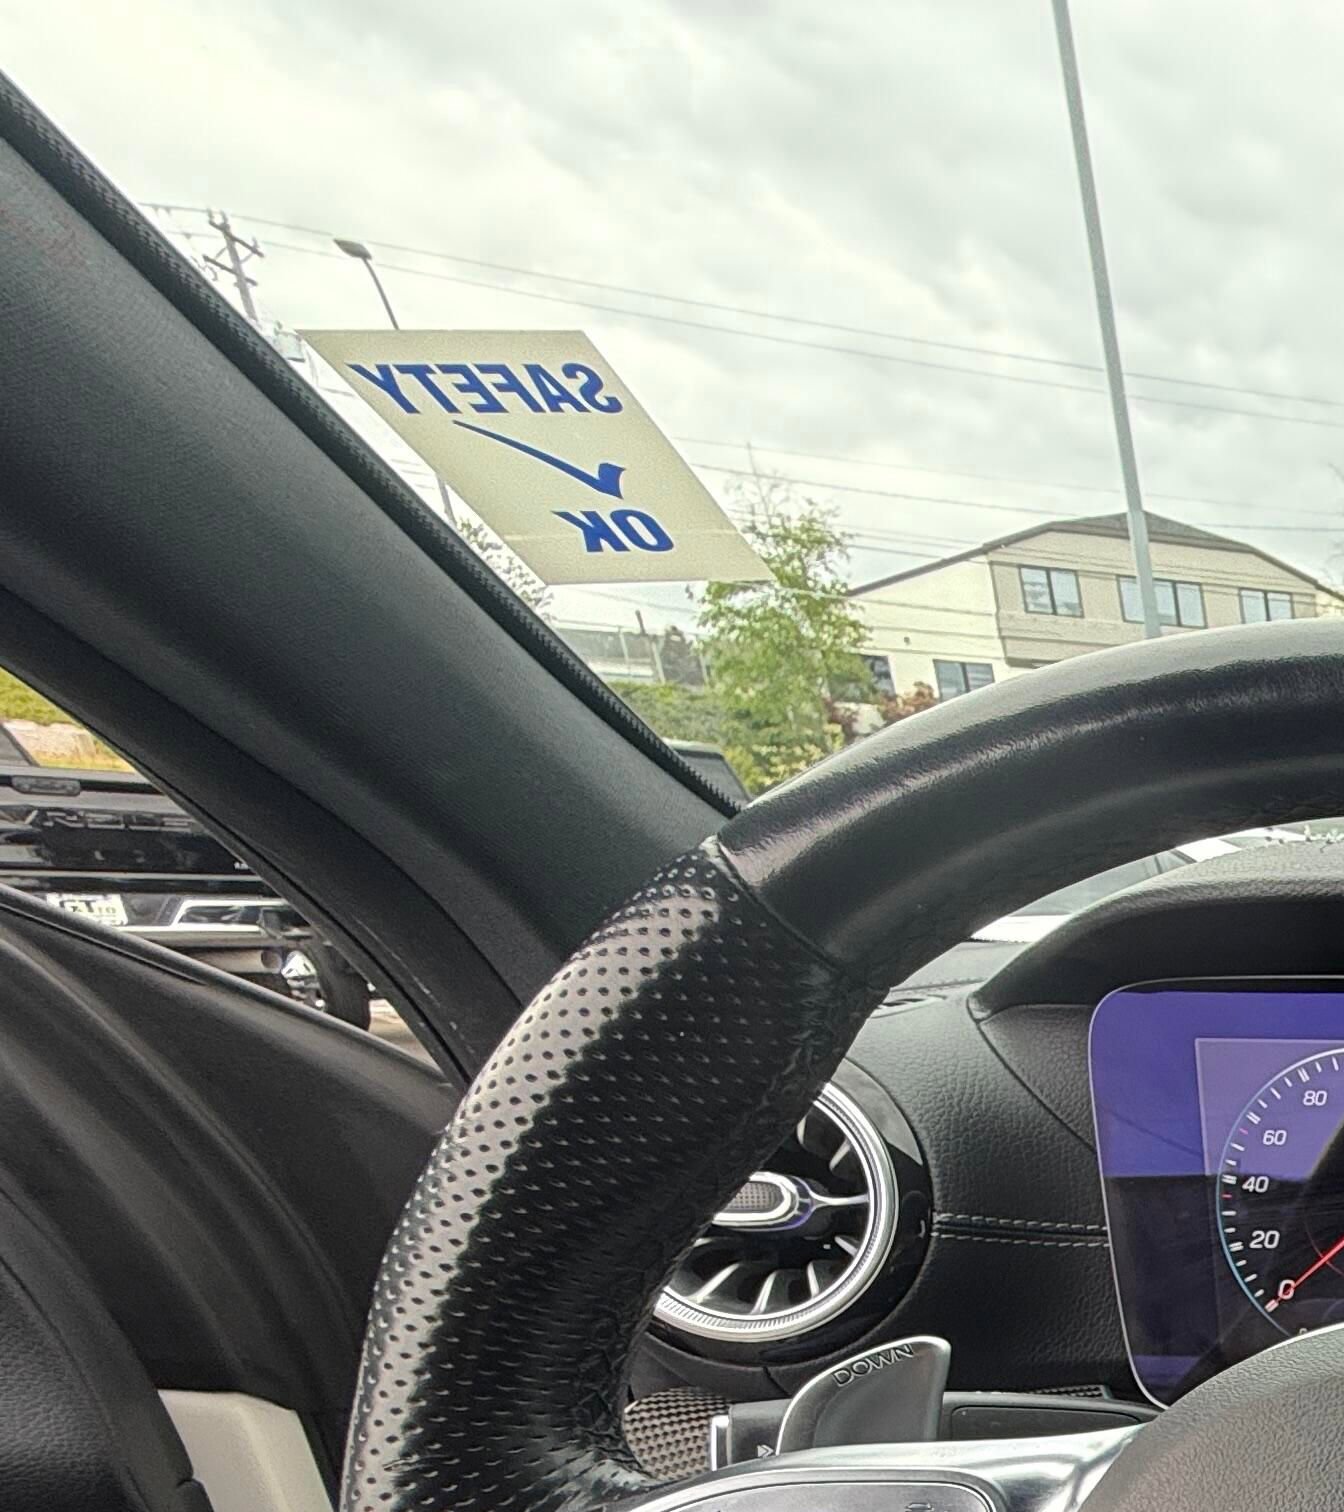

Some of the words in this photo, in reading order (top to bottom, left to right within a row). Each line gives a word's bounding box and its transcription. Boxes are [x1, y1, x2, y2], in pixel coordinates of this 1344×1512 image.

[1303, 1090, 1328, 1107] 80
[1263, 1129, 1288, 1146] 60
[1242, 1176, 1270, 1193] 40
[1249, 1230, 1280, 1250] 20
[1278, 1279, 1296, 1300] 0
[832, 1344, 914, 1387] DOWN
